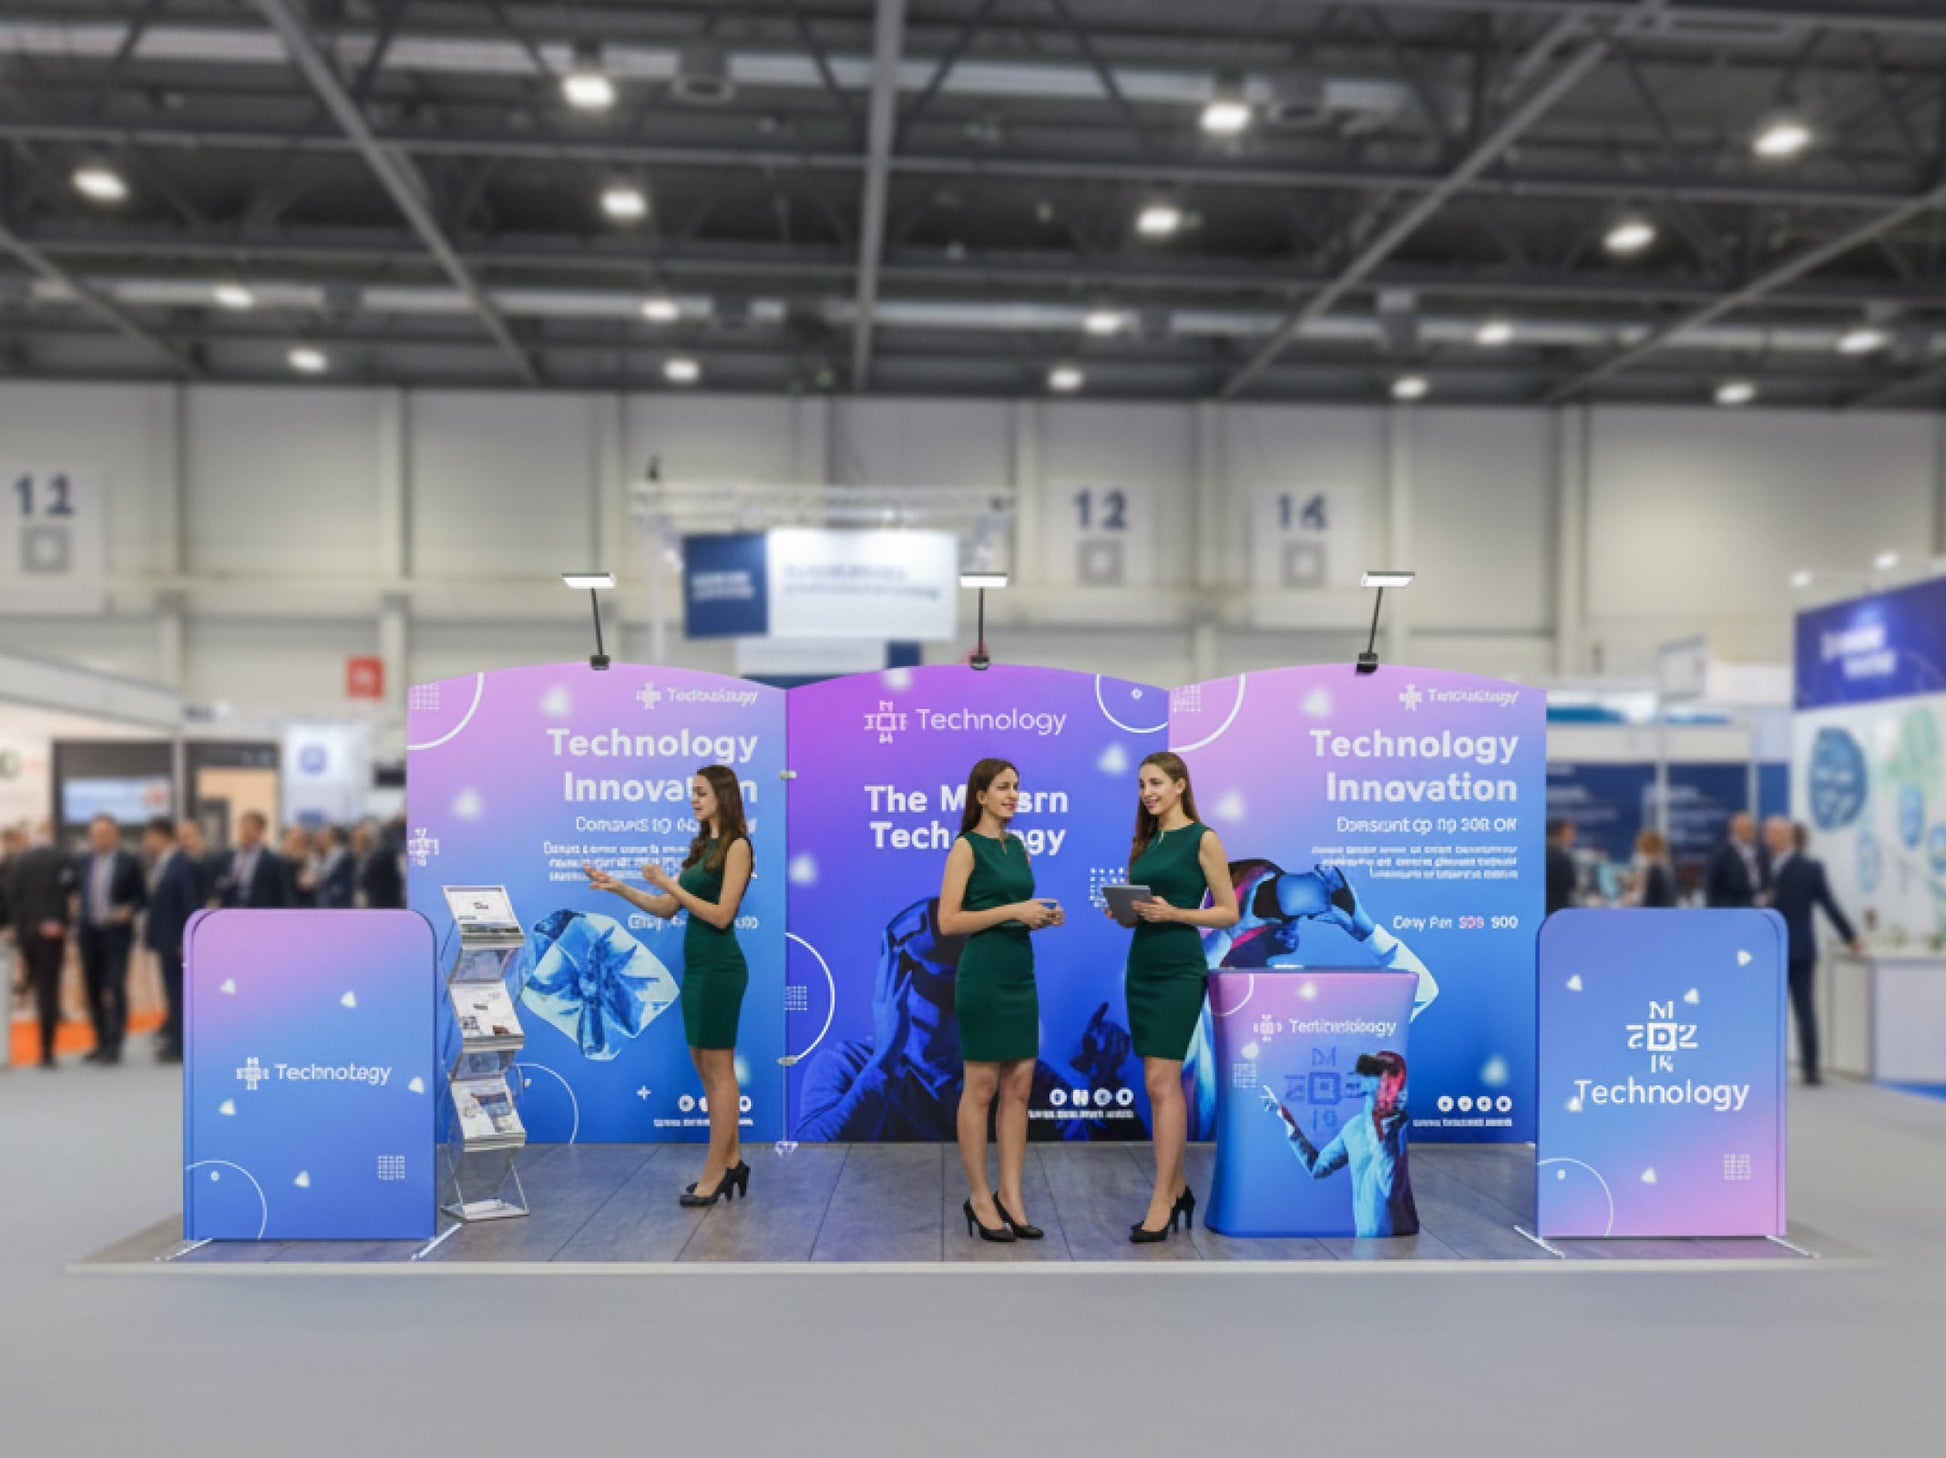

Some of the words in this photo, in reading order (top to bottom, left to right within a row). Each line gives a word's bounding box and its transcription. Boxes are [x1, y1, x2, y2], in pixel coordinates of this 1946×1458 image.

[916, 708, 1067, 735] Technology
[546, 728, 758, 764] Technology
[1309, 729, 1519, 764] Technology
[864, 784, 928, 813] The
[1327, 772, 1517, 802] Innovation
[869, 821, 1066, 856] Techgy
[1574, 1076, 1750, 1112] Technology
